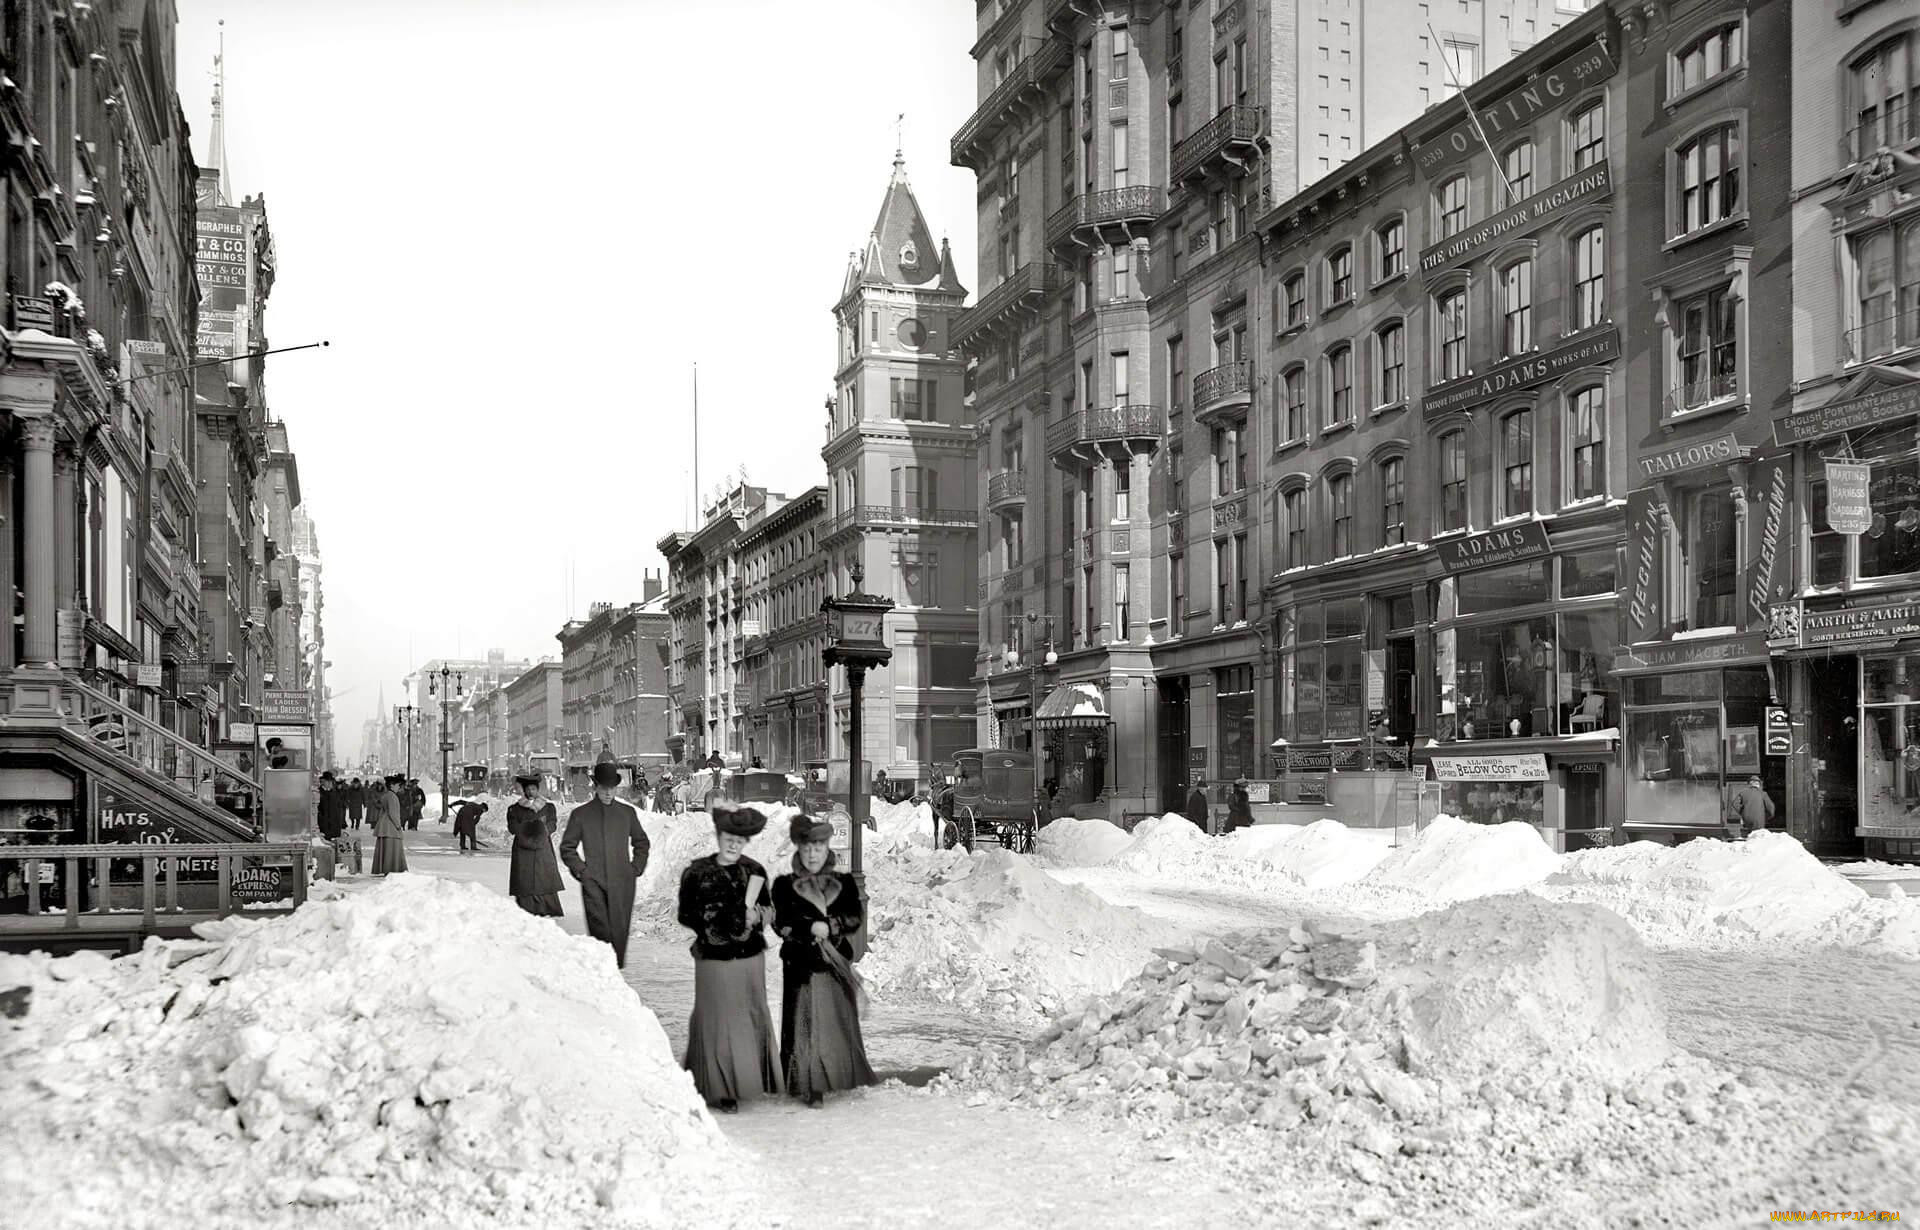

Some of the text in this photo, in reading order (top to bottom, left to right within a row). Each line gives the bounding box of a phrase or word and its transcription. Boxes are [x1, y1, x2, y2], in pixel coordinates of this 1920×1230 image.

[1421, 55, 1602, 167] 239 OUTING 239
[1422, 171, 1606, 270] THE OUT-OF-DOOR MAGAZINE
[210, 239, 220, 251] &
[223, 240, 246, 253] CO.
[1481, 359, 1548, 396] ADAMS
[1551, 351, 1579, 368] WORKS
[1581, 347, 1591, 359] OF
[1592, 341, 1609, 353] ART
[1783, 411, 1822, 429] ENGLISH
[1794, 425, 1818, 439] RARE
[1821, 411, 1868, 430] SPORTING
[1872, 402, 1906, 418] BOOKS
[1641, 439, 1731, 474] TAILORS
[1832, 485, 1866, 499] HARNESS
[1457, 529, 1525, 557] ADAMS
[1750, 467, 1786, 621] FULLENCAMP
[1630, 501, 1657, 630] RECHLIN
[1806, 613, 1855, 629] MARTIN
[1860, 611, 1869, 622] &
[264, 706, 307, 714] HAIR DRESSER
[1456, 763, 1518, 777] BELOW COST
[101, 809, 153, 830] HATS,
[232, 868, 281, 887] ADAMS
[237, 881, 273, 891] EXPRESS
[231, 890, 279, 898] COMPANY
